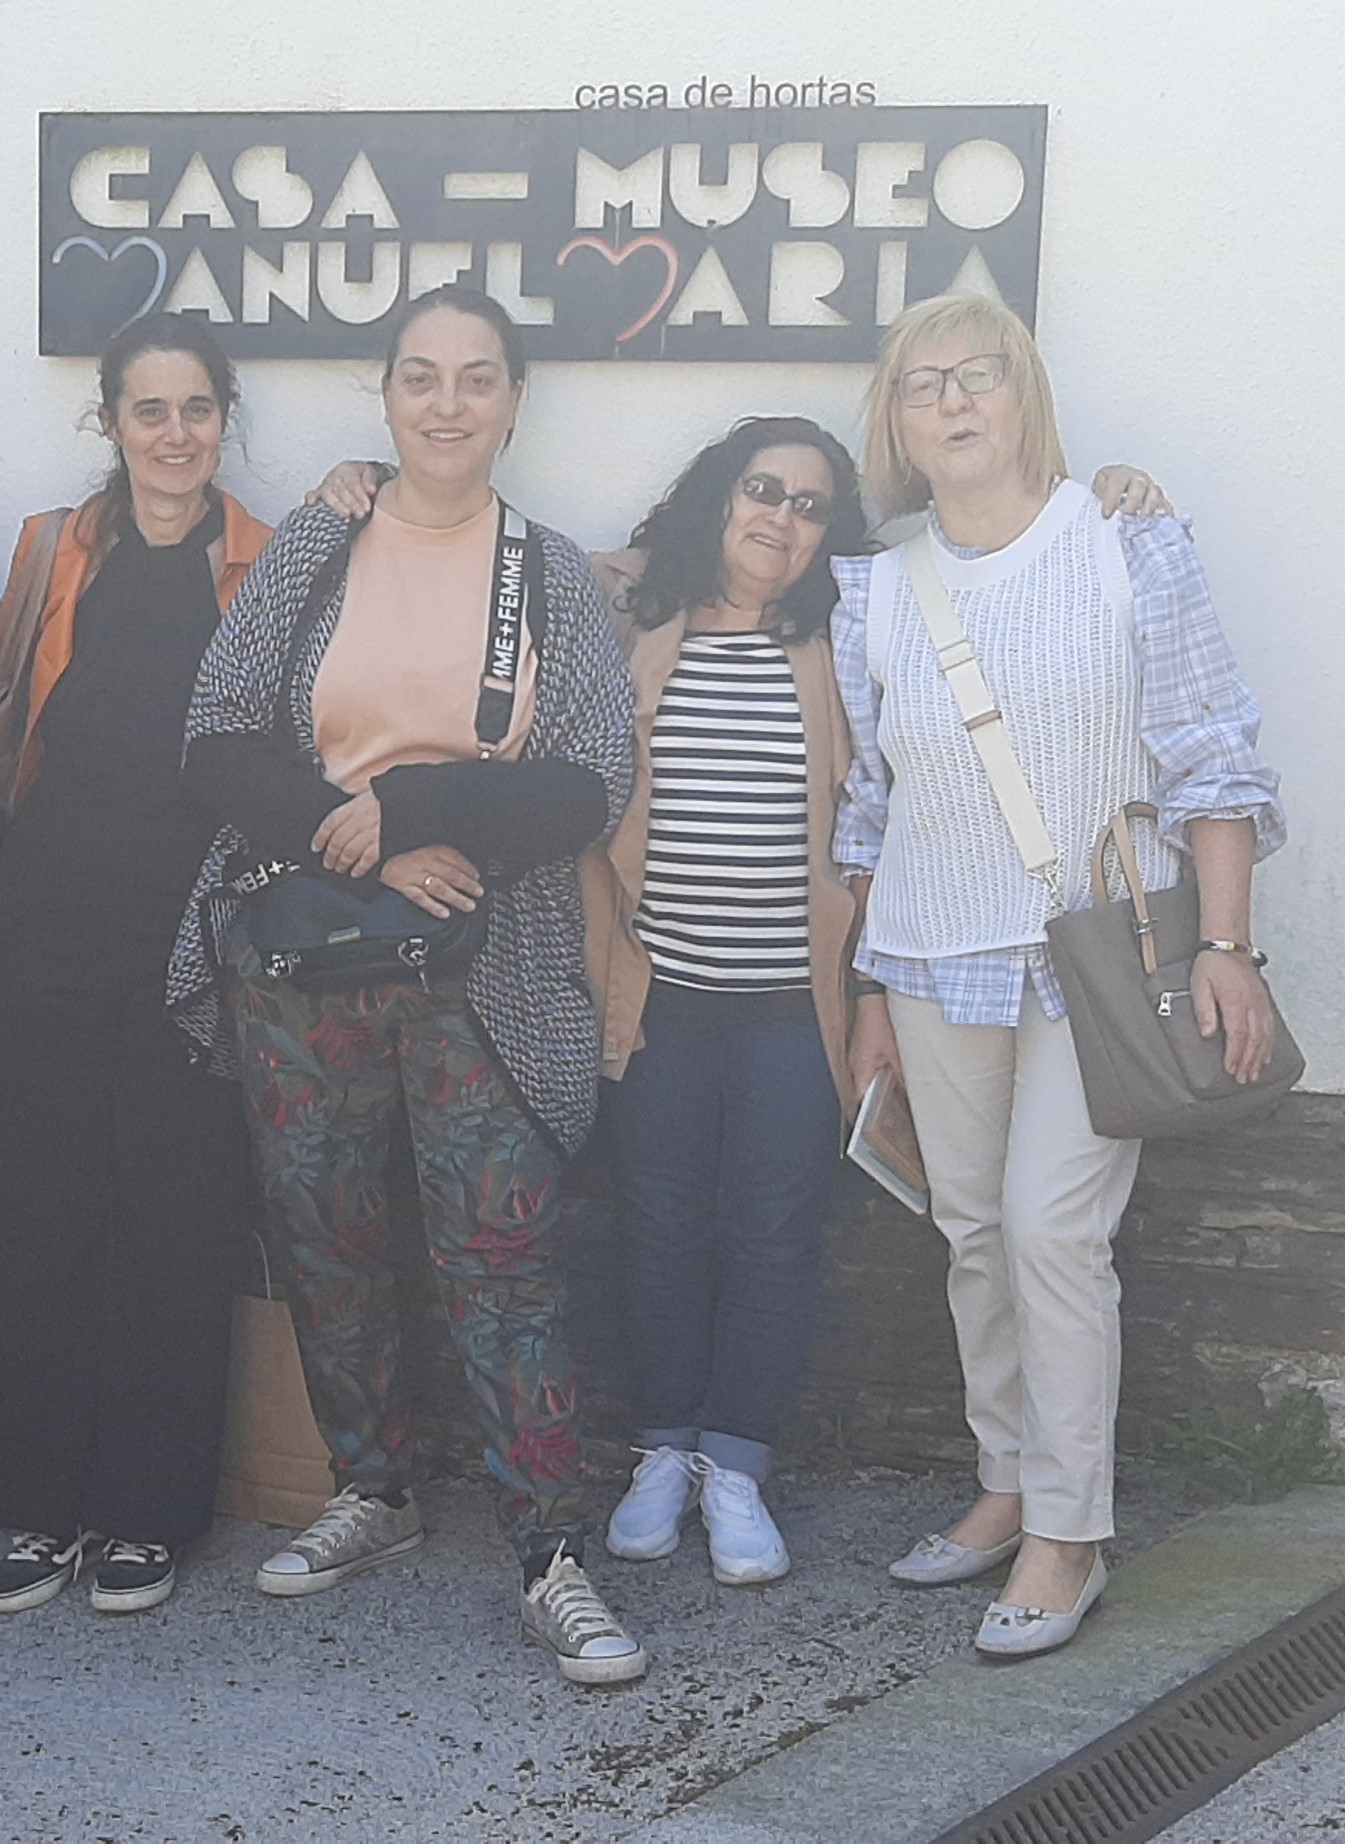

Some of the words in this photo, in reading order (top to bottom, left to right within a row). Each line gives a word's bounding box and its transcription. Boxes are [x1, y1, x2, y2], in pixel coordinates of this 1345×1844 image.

[574, 81, 669, 110] casa
[684, 75, 733, 109] de
[749, 74, 877, 109] hortas
[69, 145, 401, 230] CASA
[574, 138, 1025, 231] MUSEO
